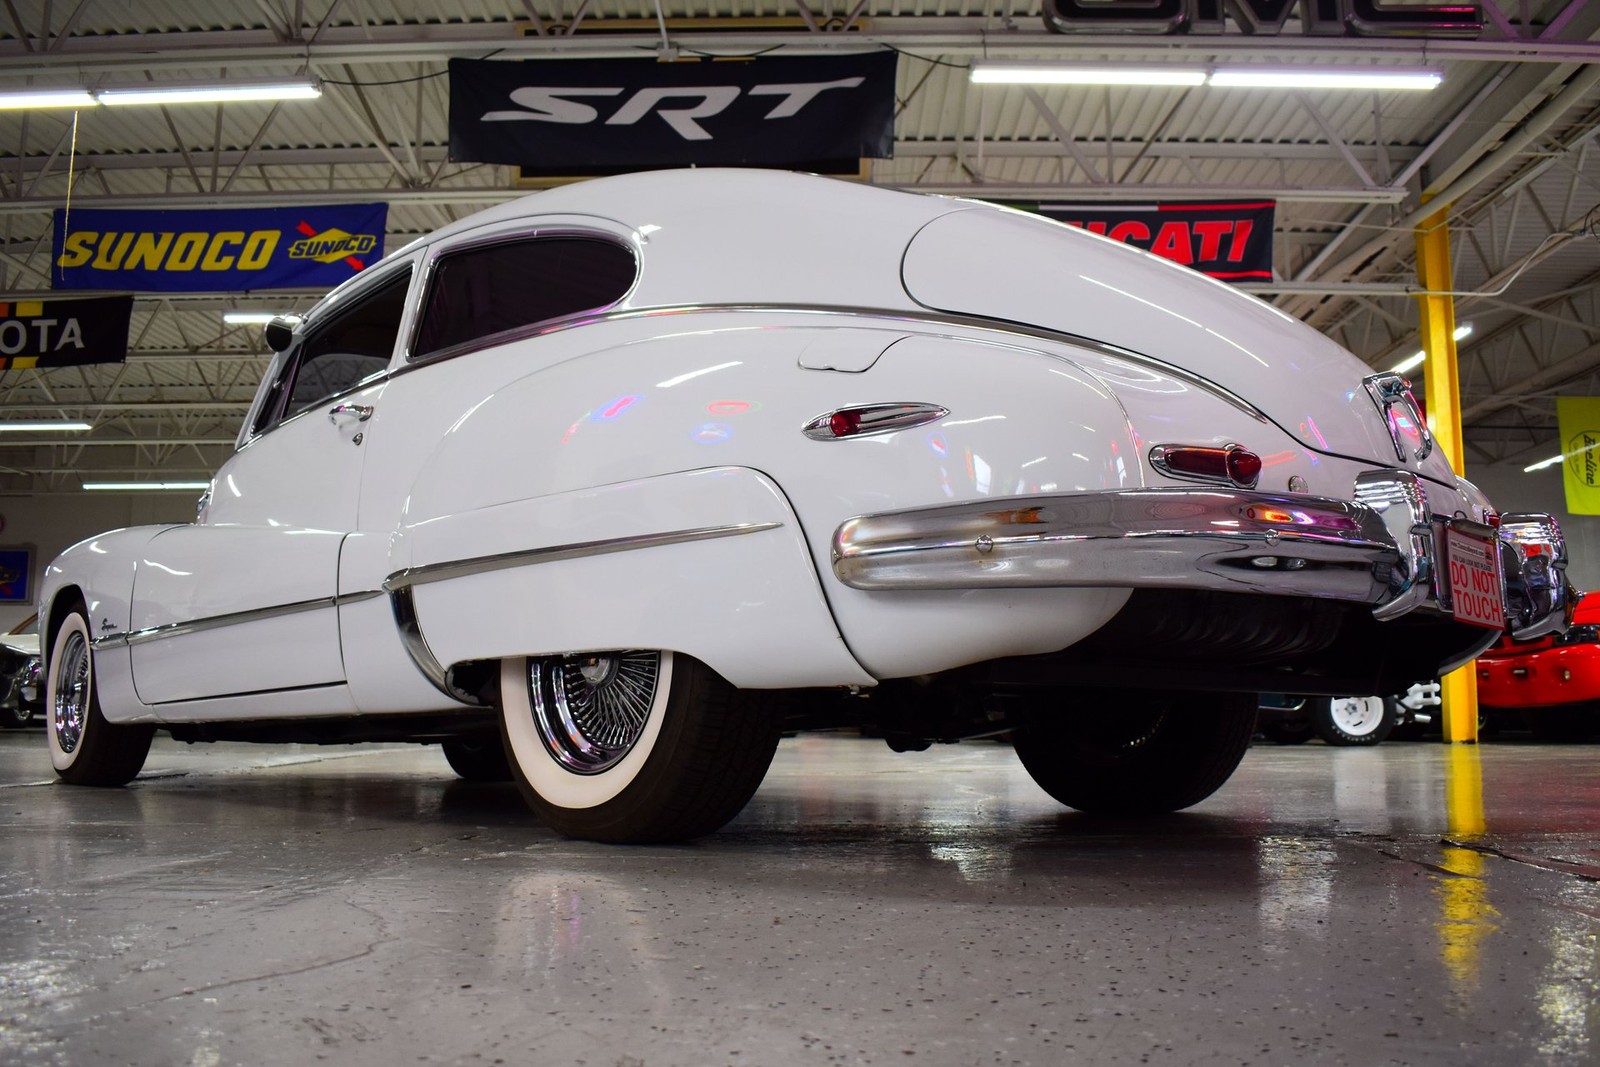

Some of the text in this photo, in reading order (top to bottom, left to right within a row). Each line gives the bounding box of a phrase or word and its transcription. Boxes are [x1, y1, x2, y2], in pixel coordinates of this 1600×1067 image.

[480, 76, 866, 141] SRT
[57, 229, 282, 271] SUNOCO
[291, 236, 374, 257] SUNOCO
[1064, 219, 1253, 265] CATI
[1451, 560, 1495, 595] DO NOT
[1454, 589, 1500, 622] TOUCH
